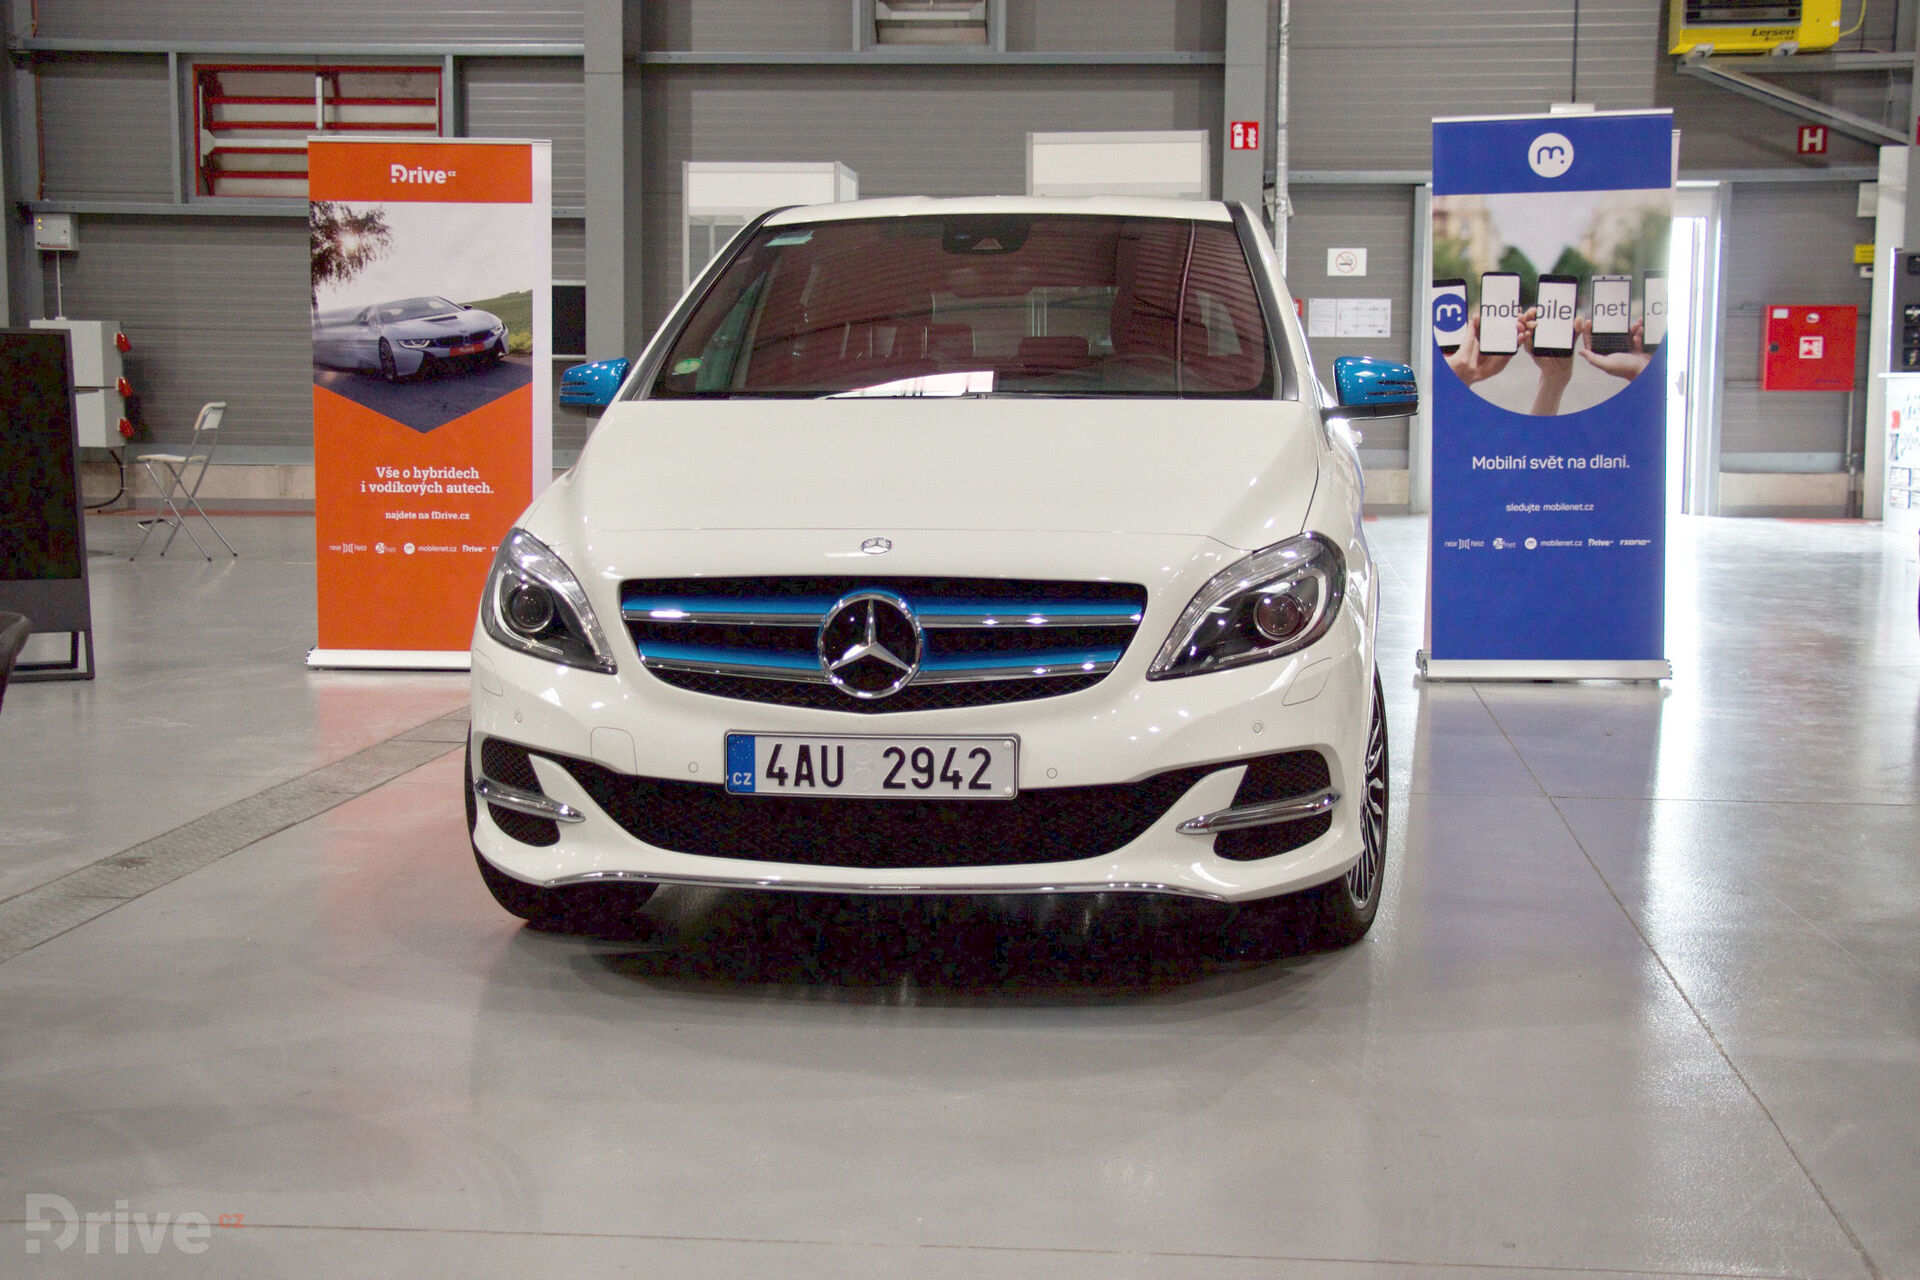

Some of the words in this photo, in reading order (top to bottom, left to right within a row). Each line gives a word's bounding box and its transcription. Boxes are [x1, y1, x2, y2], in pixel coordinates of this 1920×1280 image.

[1802, 128, 1823, 152] H
[1594, 301, 1627, 317] net
[1472, 455, 1527, 470] Mobilní
[1529, 455, 1564, 469] svět
[1567, 457, 1586, 469] na
[1589, 454, 1630, 469] dlani.
[376, 466, 400, 479] Vše
[402, 469, 411, 479] o
[413, 466, 480, 481] hybridech
[361, 480, 367, 493] i
[368, 481, 443, 496] vodíkových
[446, 482, 494, 494] autech.
[385, 510, 417, 520] najdete
[418, 512, 430, 520] na
[431, 511, 471, 520] fDrive.cz
[1506, 503, 1541, 514] sledujte
[1543, 502, 1594, 512] mobilenet.cz
[732, 772, 752, 785] CZ
[766, 743, 844, 788] 4AU
[883, 746, 992, 790] 2942
